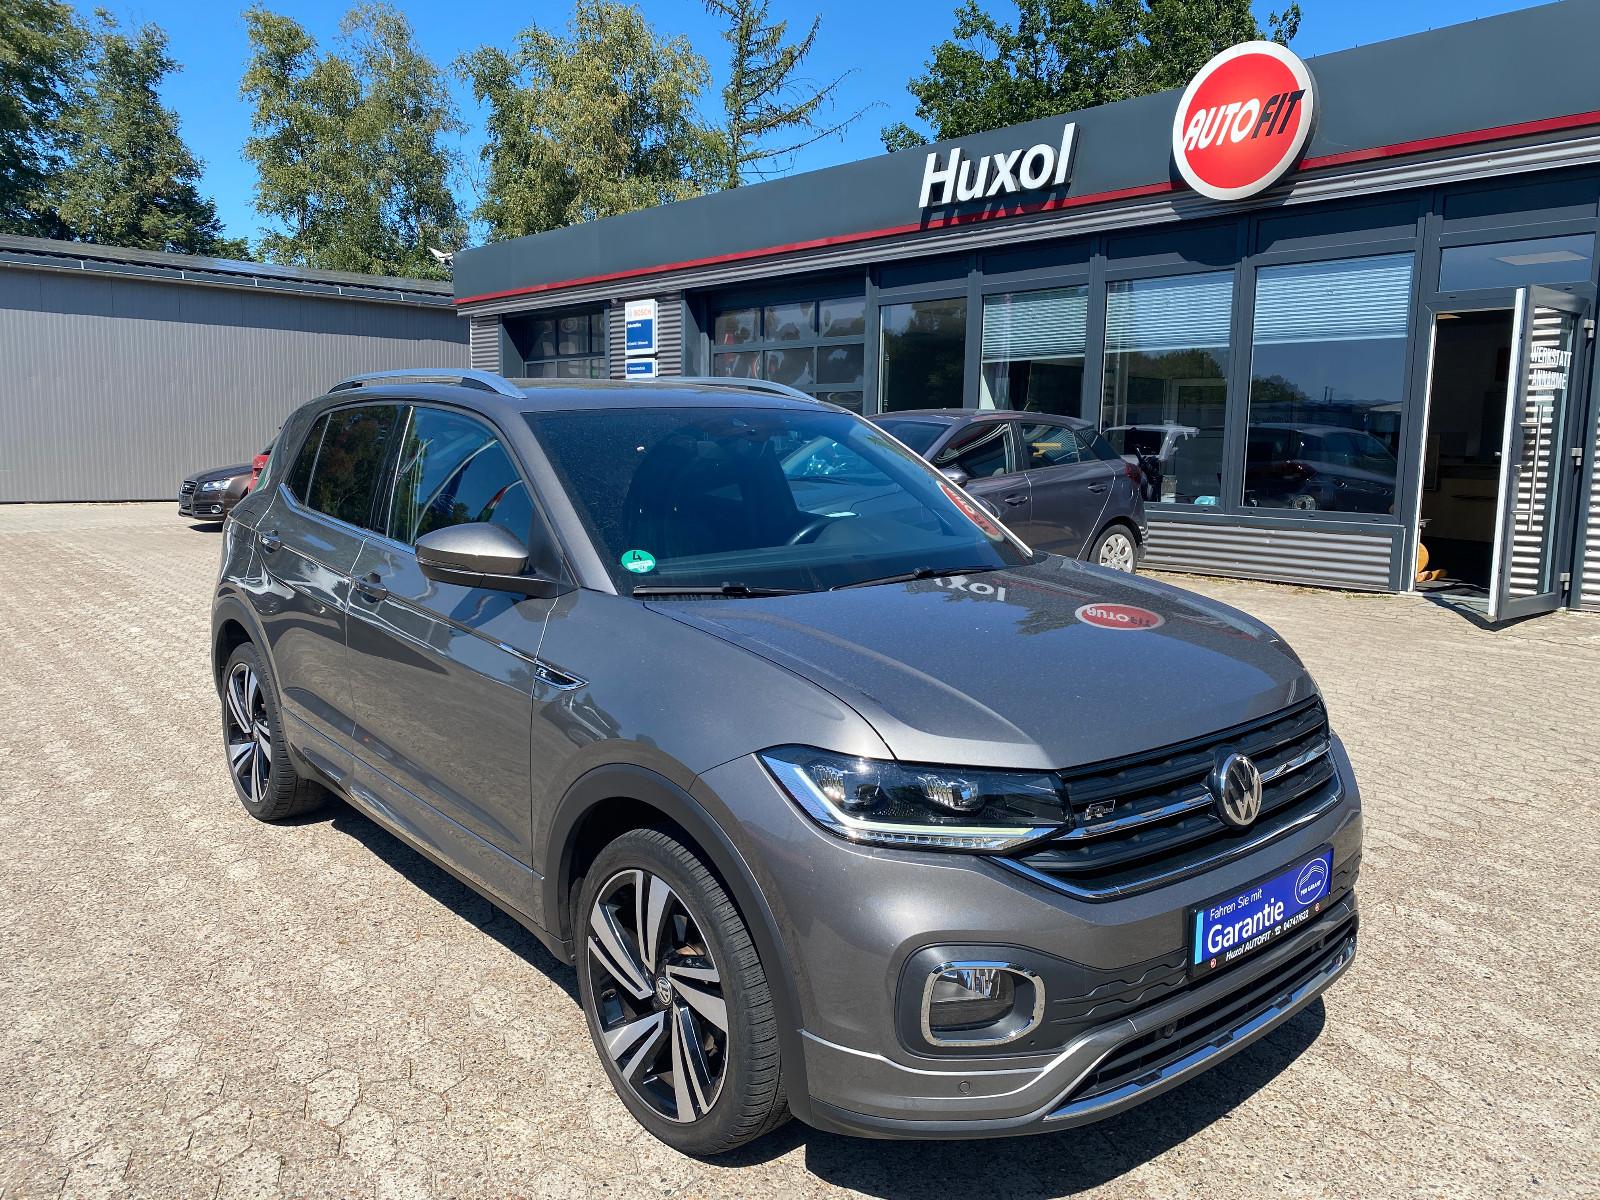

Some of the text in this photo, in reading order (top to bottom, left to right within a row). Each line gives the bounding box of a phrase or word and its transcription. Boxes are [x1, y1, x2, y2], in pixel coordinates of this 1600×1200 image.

[1182, 88, 1306, 151] AUTOFIT
[918, 122, 1077, 209] Huxol
[1207, 898, 1284, 954] Garantie
[1209, 888, 1263, 921] Fahren Sie mit
[1225, 943, 1244, 961] Huxol
[1244, 931, 1272, 951] AUTOFIT
